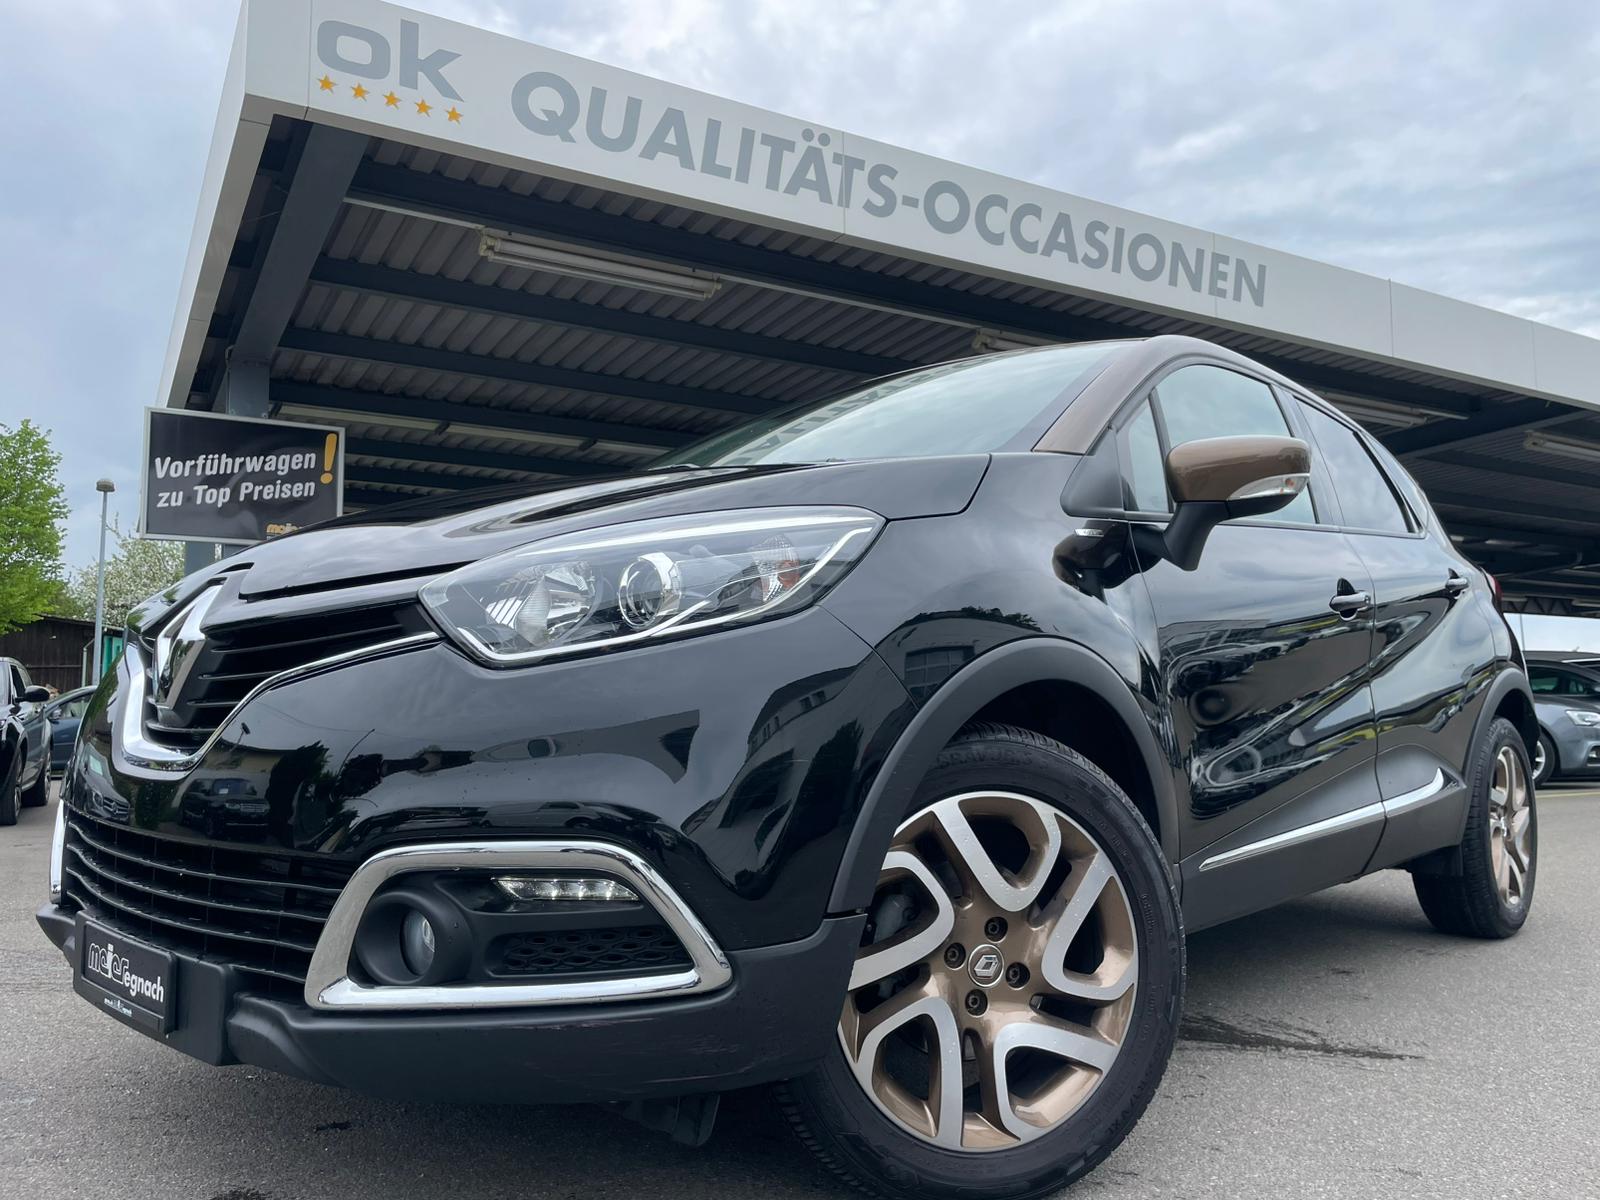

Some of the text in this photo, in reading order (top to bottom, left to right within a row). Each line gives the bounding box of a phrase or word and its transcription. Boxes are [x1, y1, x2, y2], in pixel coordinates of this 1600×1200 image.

[316, 18, 1267, 307] ok QUALITÄTS-OCCASIONEN
[154, 452, 317, 479] Vorführwagen
[156, 479, 316, 508] zu Top Preisen
[124, 972, 165, 1003] egnach
